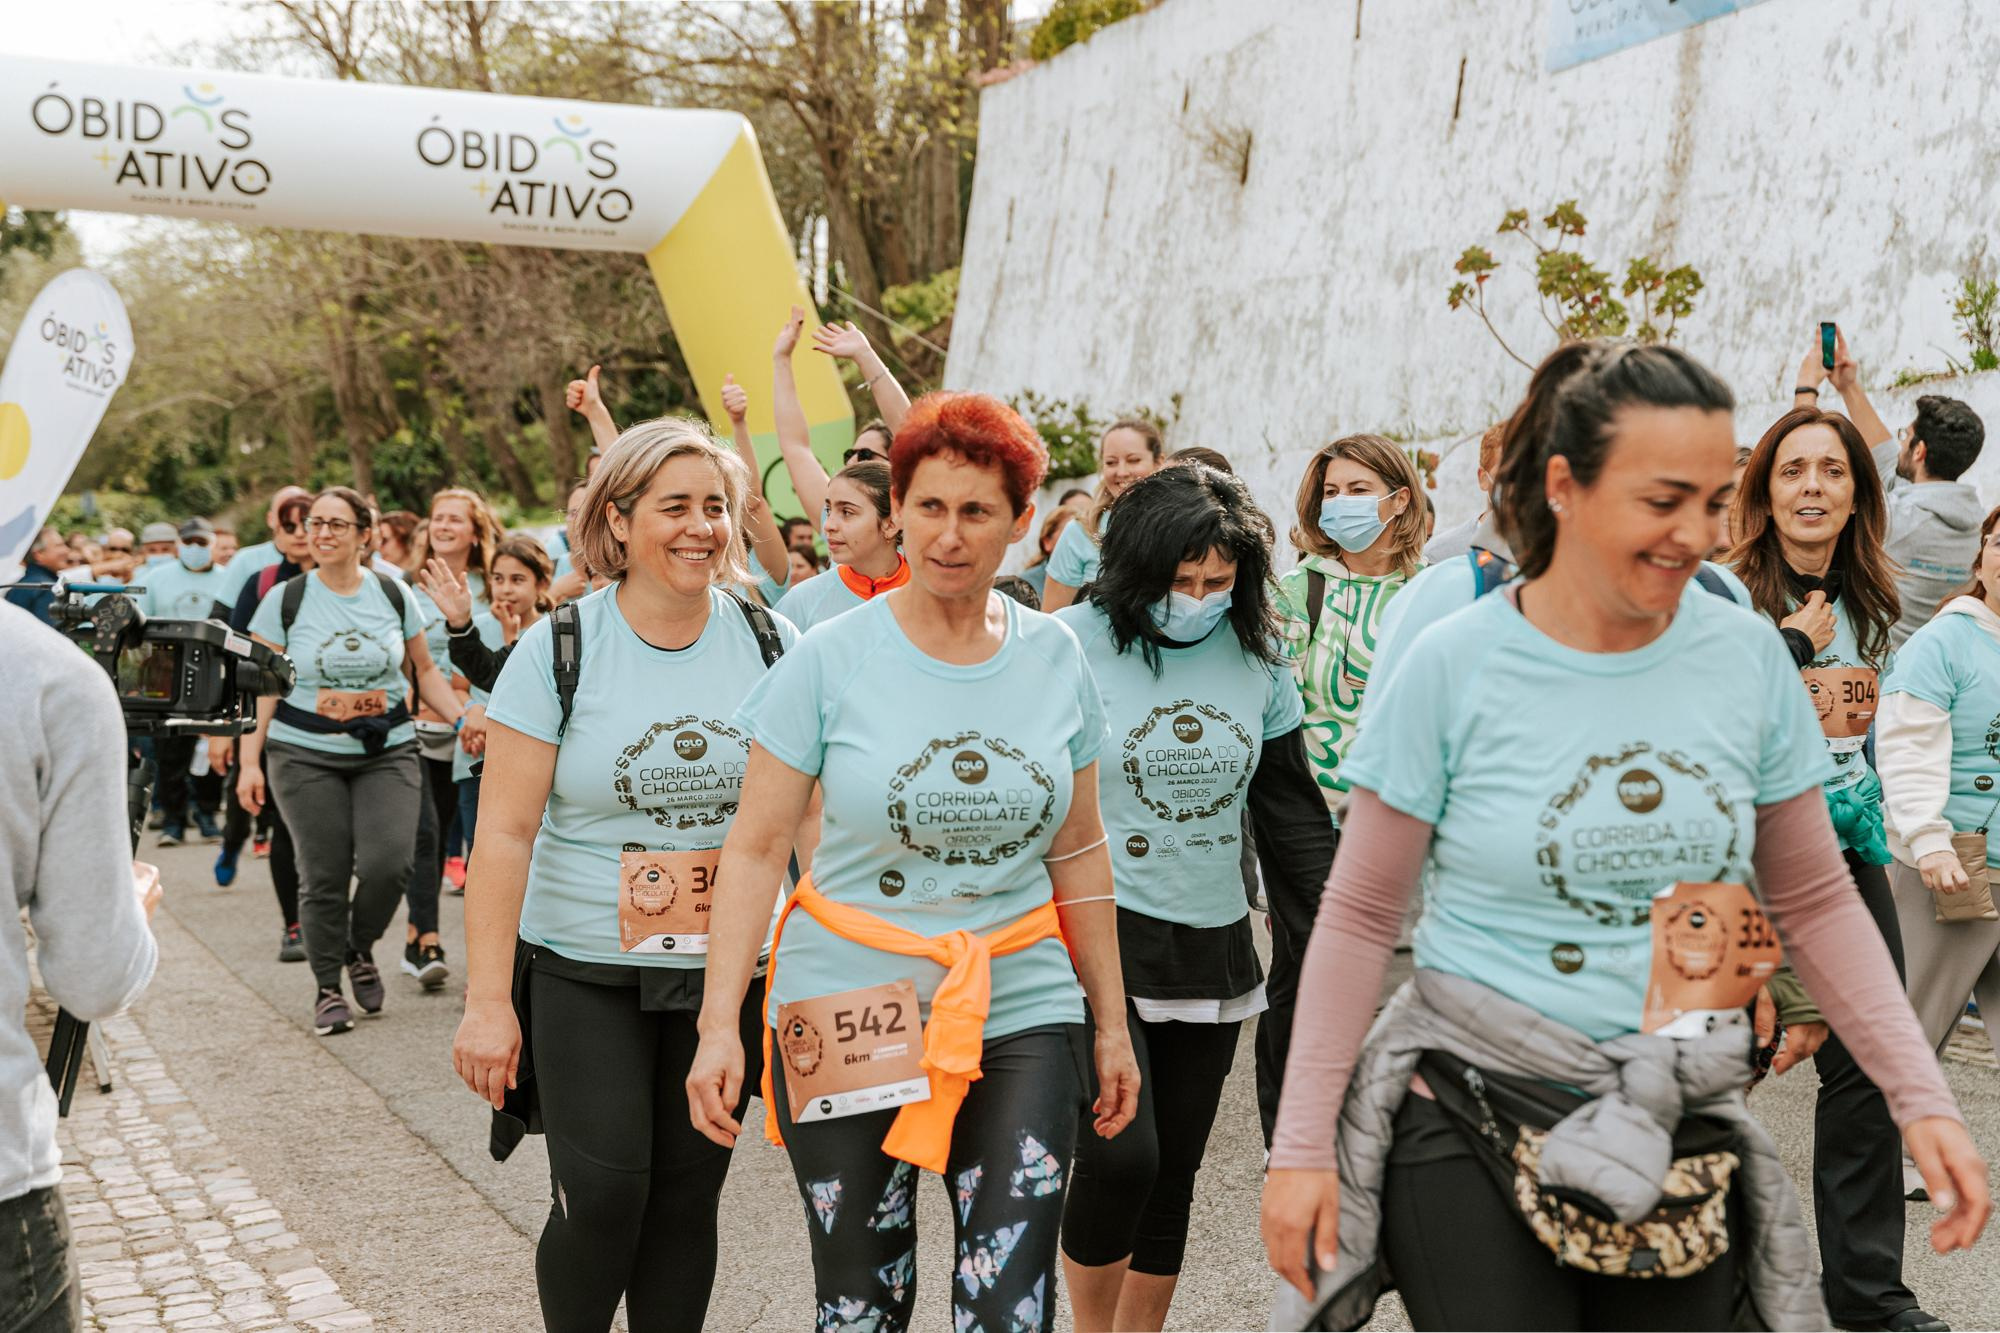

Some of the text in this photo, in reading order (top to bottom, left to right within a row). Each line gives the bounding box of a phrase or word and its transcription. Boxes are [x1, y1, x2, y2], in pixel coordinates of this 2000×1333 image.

[1842, 681, 1875, 703] 304
[353, 697, 382, 712] 454
[1146, 745, 1239, 762] CORRIDA DO
[640, 761, 748, 781] CORRIDA DO
[1147, 761, 1239, 777] CHOCOLATE
[641, 777, 744, 795] CHOCOLATE
[916, 788, 1033, 808] CORRIDA DO
[916, 807, 1031, 825] CHOCOLATE
[1572, 818, 1718, 850] CORRIDA DO
[1573, 843, 1717, 874] CHOCOLATE
[835, 1002, 906, 1043] 542
[844, 1051, 870, 1065] 6km
